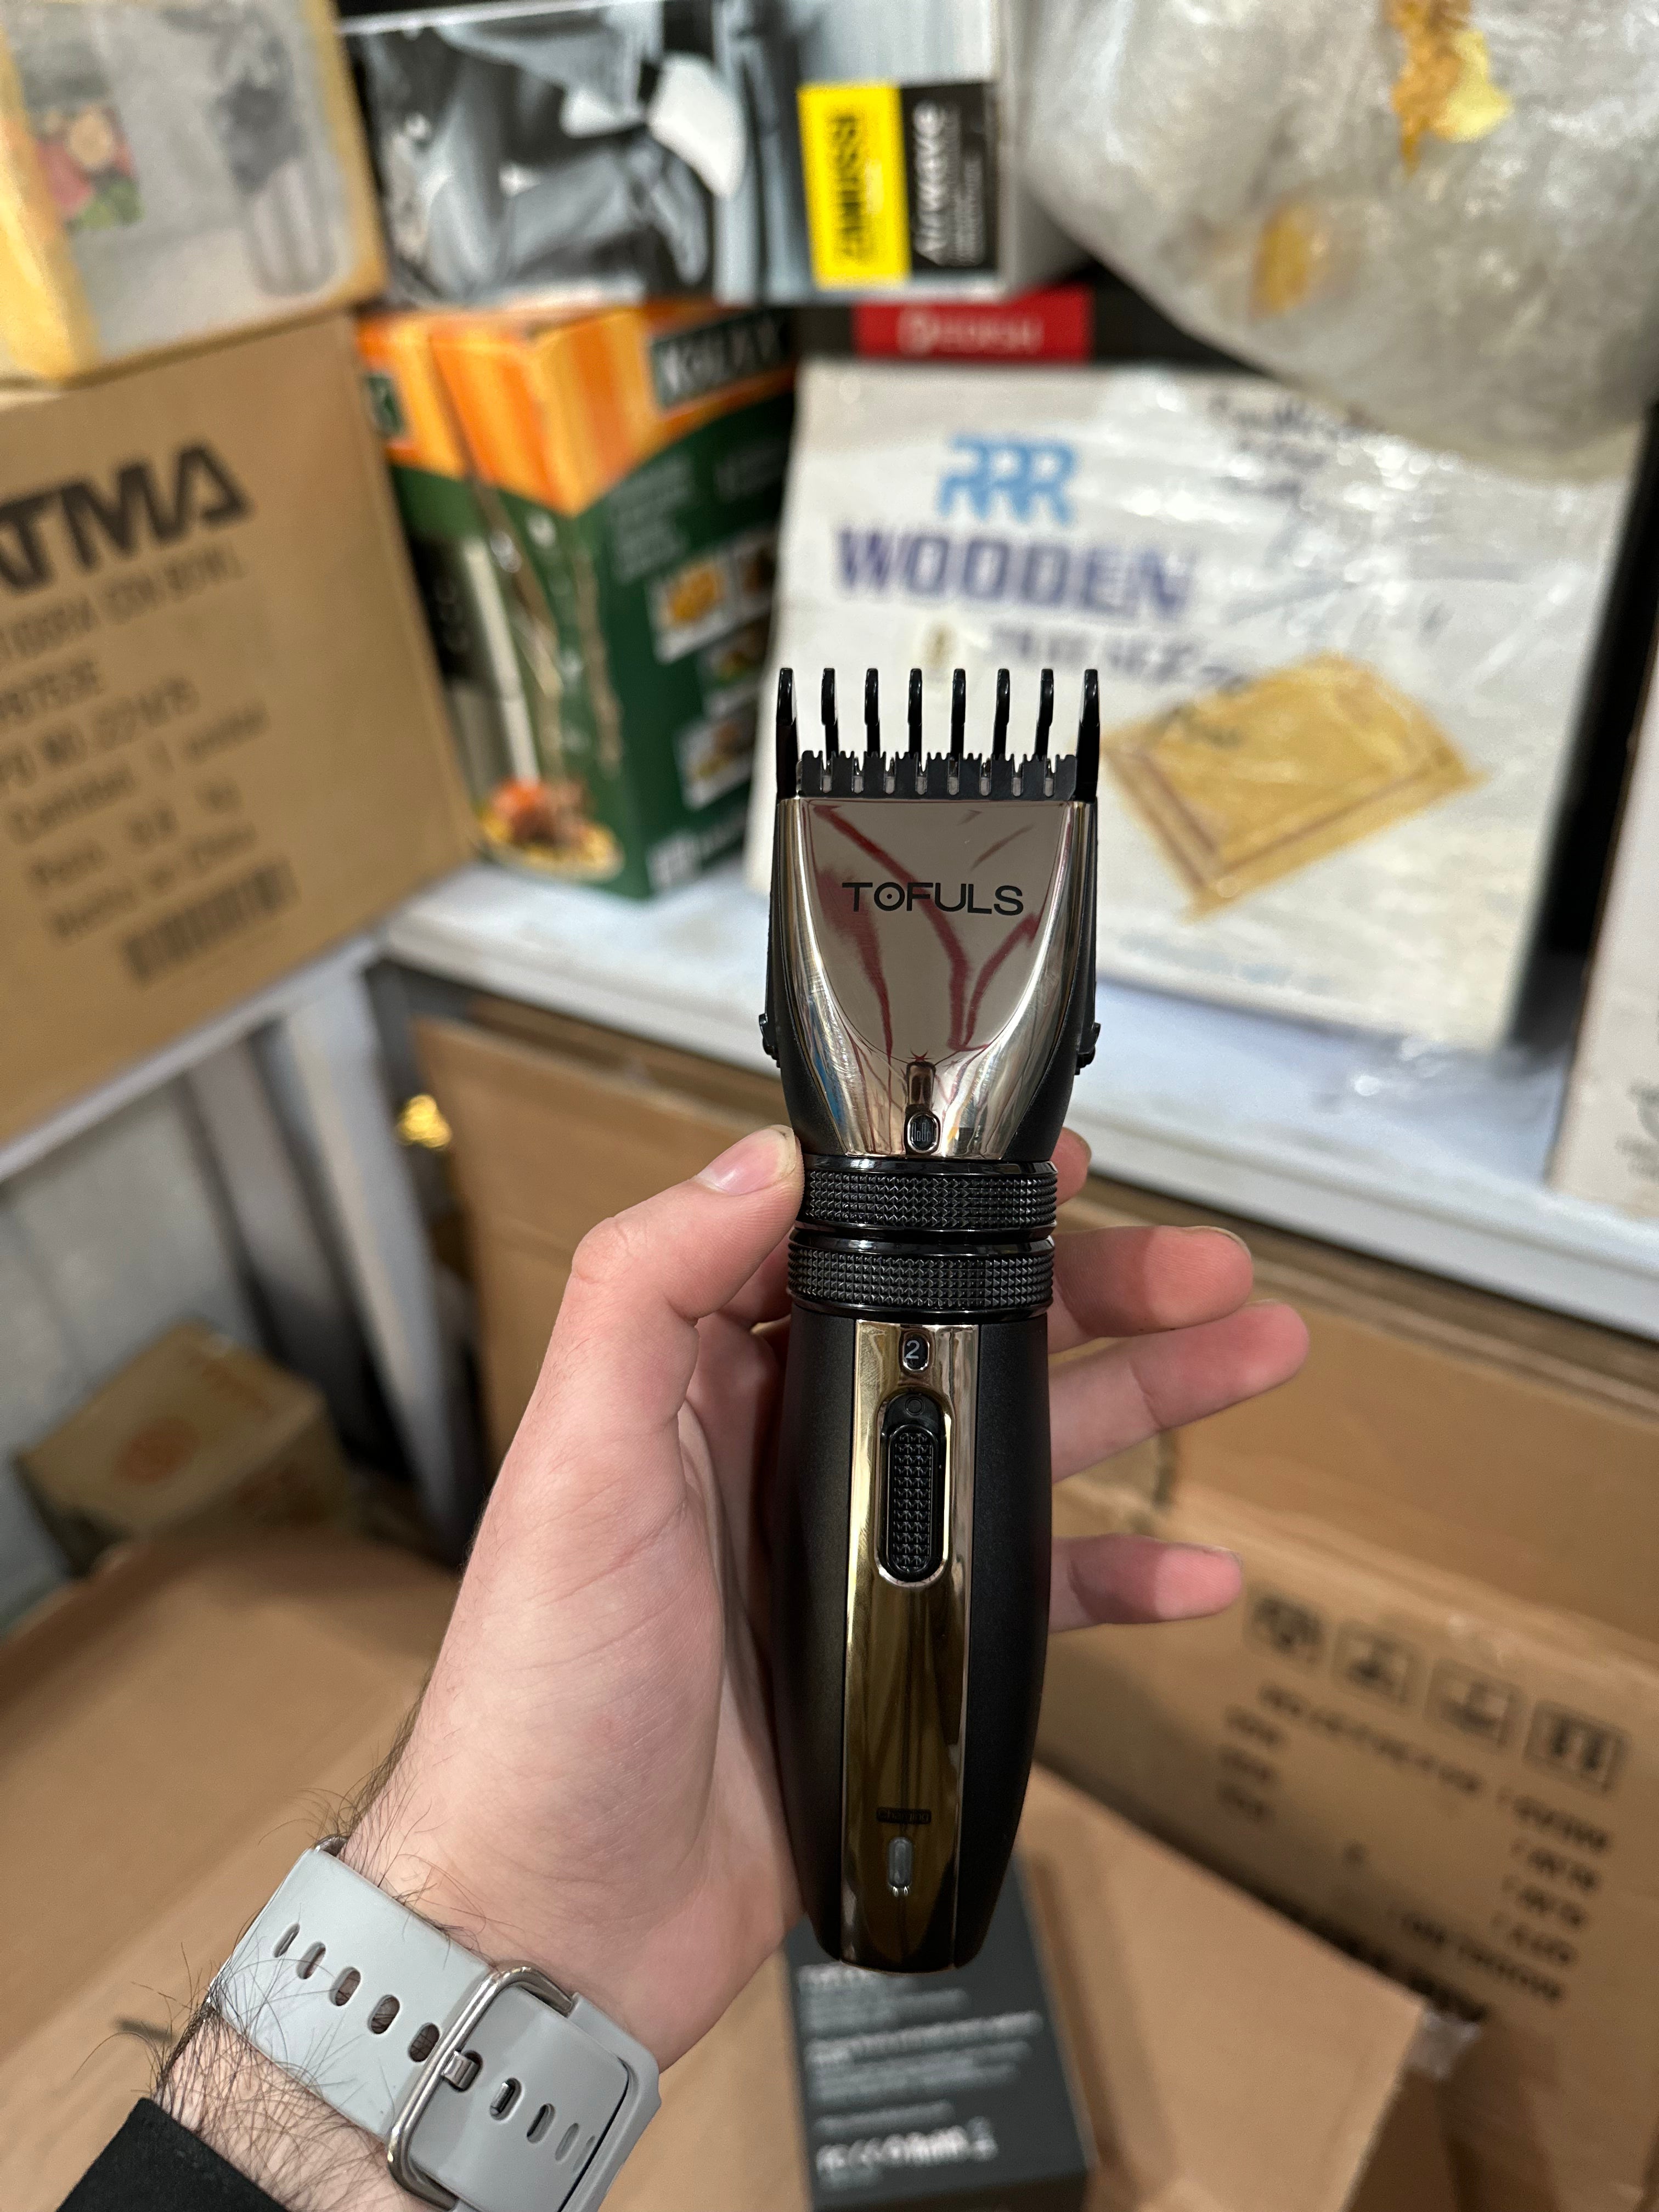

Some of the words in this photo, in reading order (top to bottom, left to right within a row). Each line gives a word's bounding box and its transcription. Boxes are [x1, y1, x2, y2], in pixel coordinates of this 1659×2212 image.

[0, 443, 255, 591] TMA
[837, 525, 1194, 621] WOODEN
[842, 881, 1024, 916] TOFULS
[905, 1340, 919, 1359] 2
